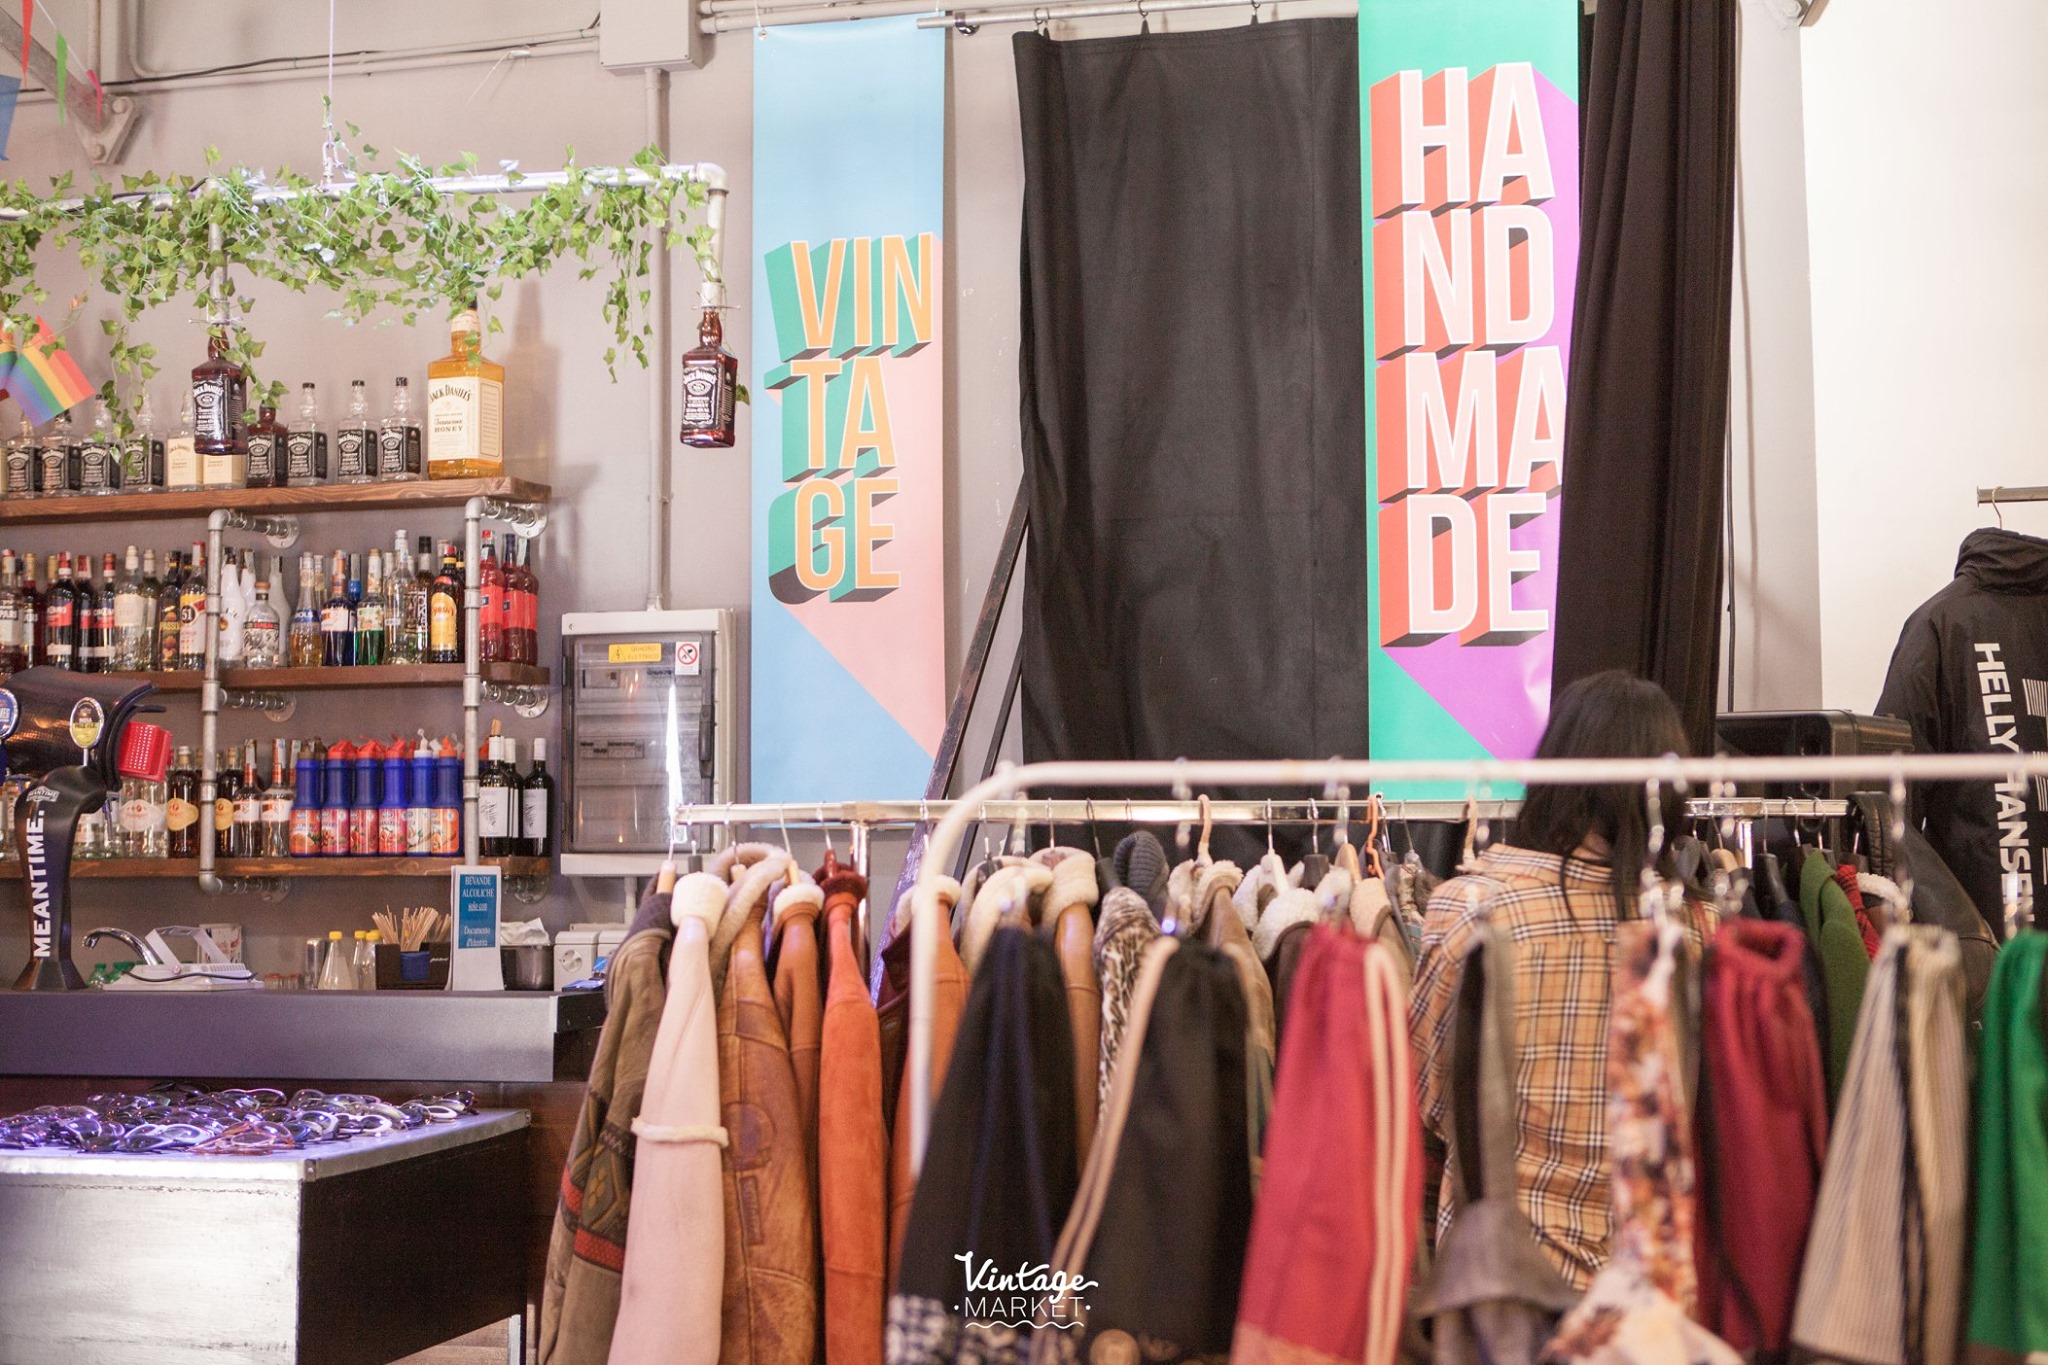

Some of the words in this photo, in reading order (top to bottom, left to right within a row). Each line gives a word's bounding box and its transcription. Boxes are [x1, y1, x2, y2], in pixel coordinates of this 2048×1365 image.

[1400, 62, 1555, 204] HA
[790, 232, 933, 349] VIN
[1402, 205, 1554, 345] ND
[790, 356, 897, 469] TA
[1405, 346, 1566, 488] MA
[794, 478, 901, 591] GE
[1407, 492, 1548, 633] DE
[182, 608, 193, 620] 51
[1974, 643, 2019, 752] HELLY
[462, 888, 494, 898] ALCOLICHE
[465, 876, 491, 886] BEVANDE
